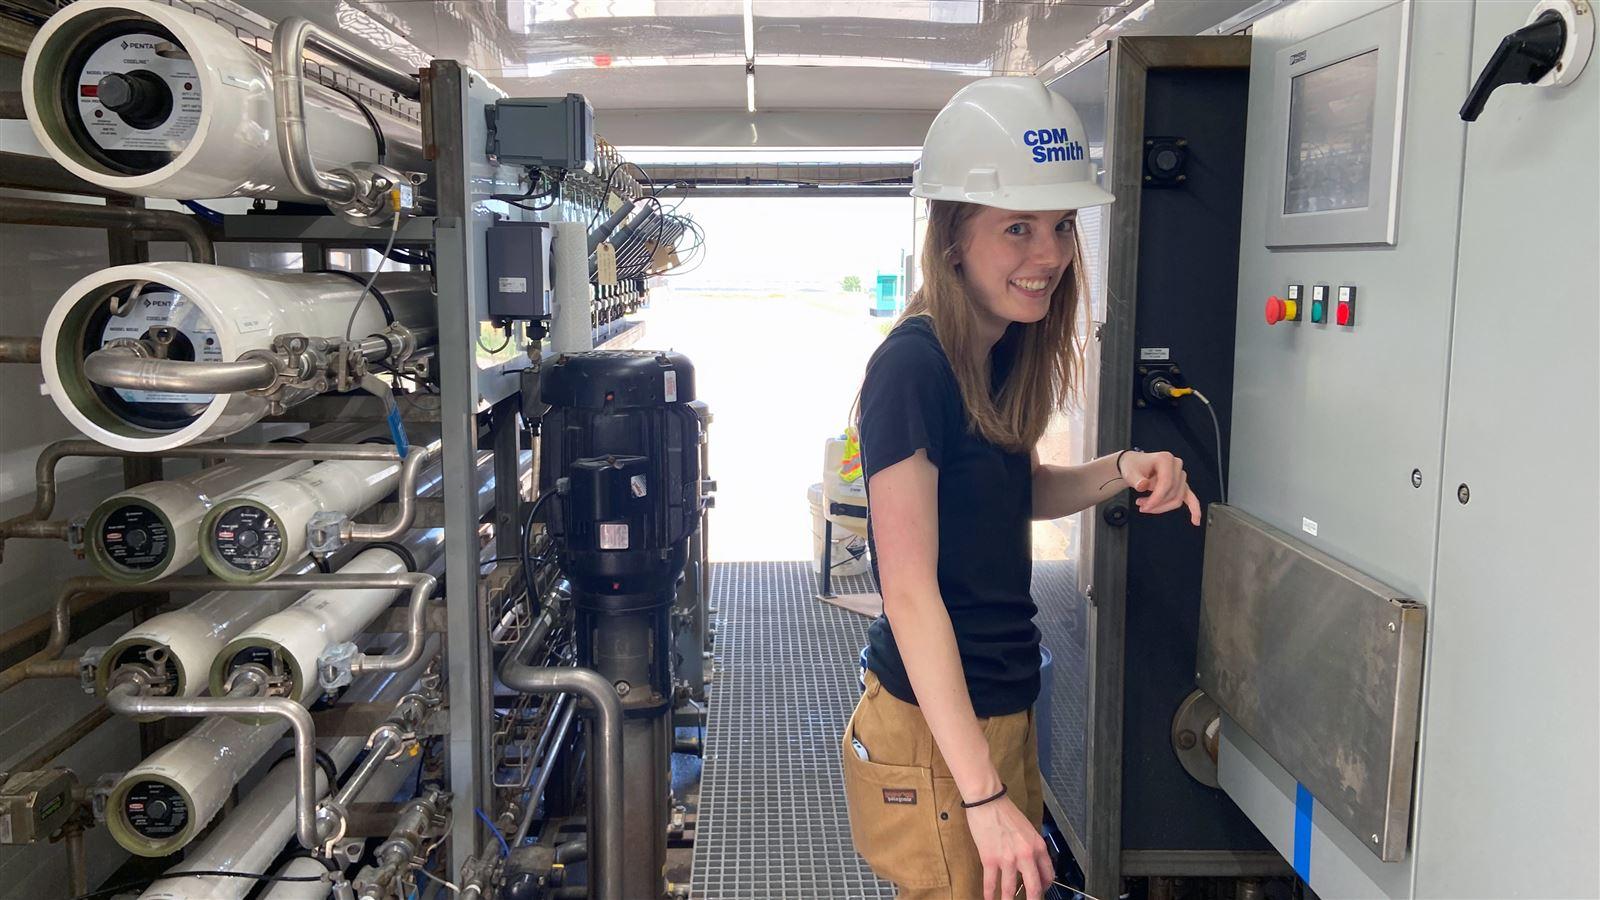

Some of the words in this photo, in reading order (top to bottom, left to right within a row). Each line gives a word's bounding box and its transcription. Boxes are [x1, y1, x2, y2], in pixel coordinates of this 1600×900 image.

[129, 42, 155, 50] PENTA
[1023, 128, 1069, 146] CDM
[1032, 141, 1084, 163] Smith
